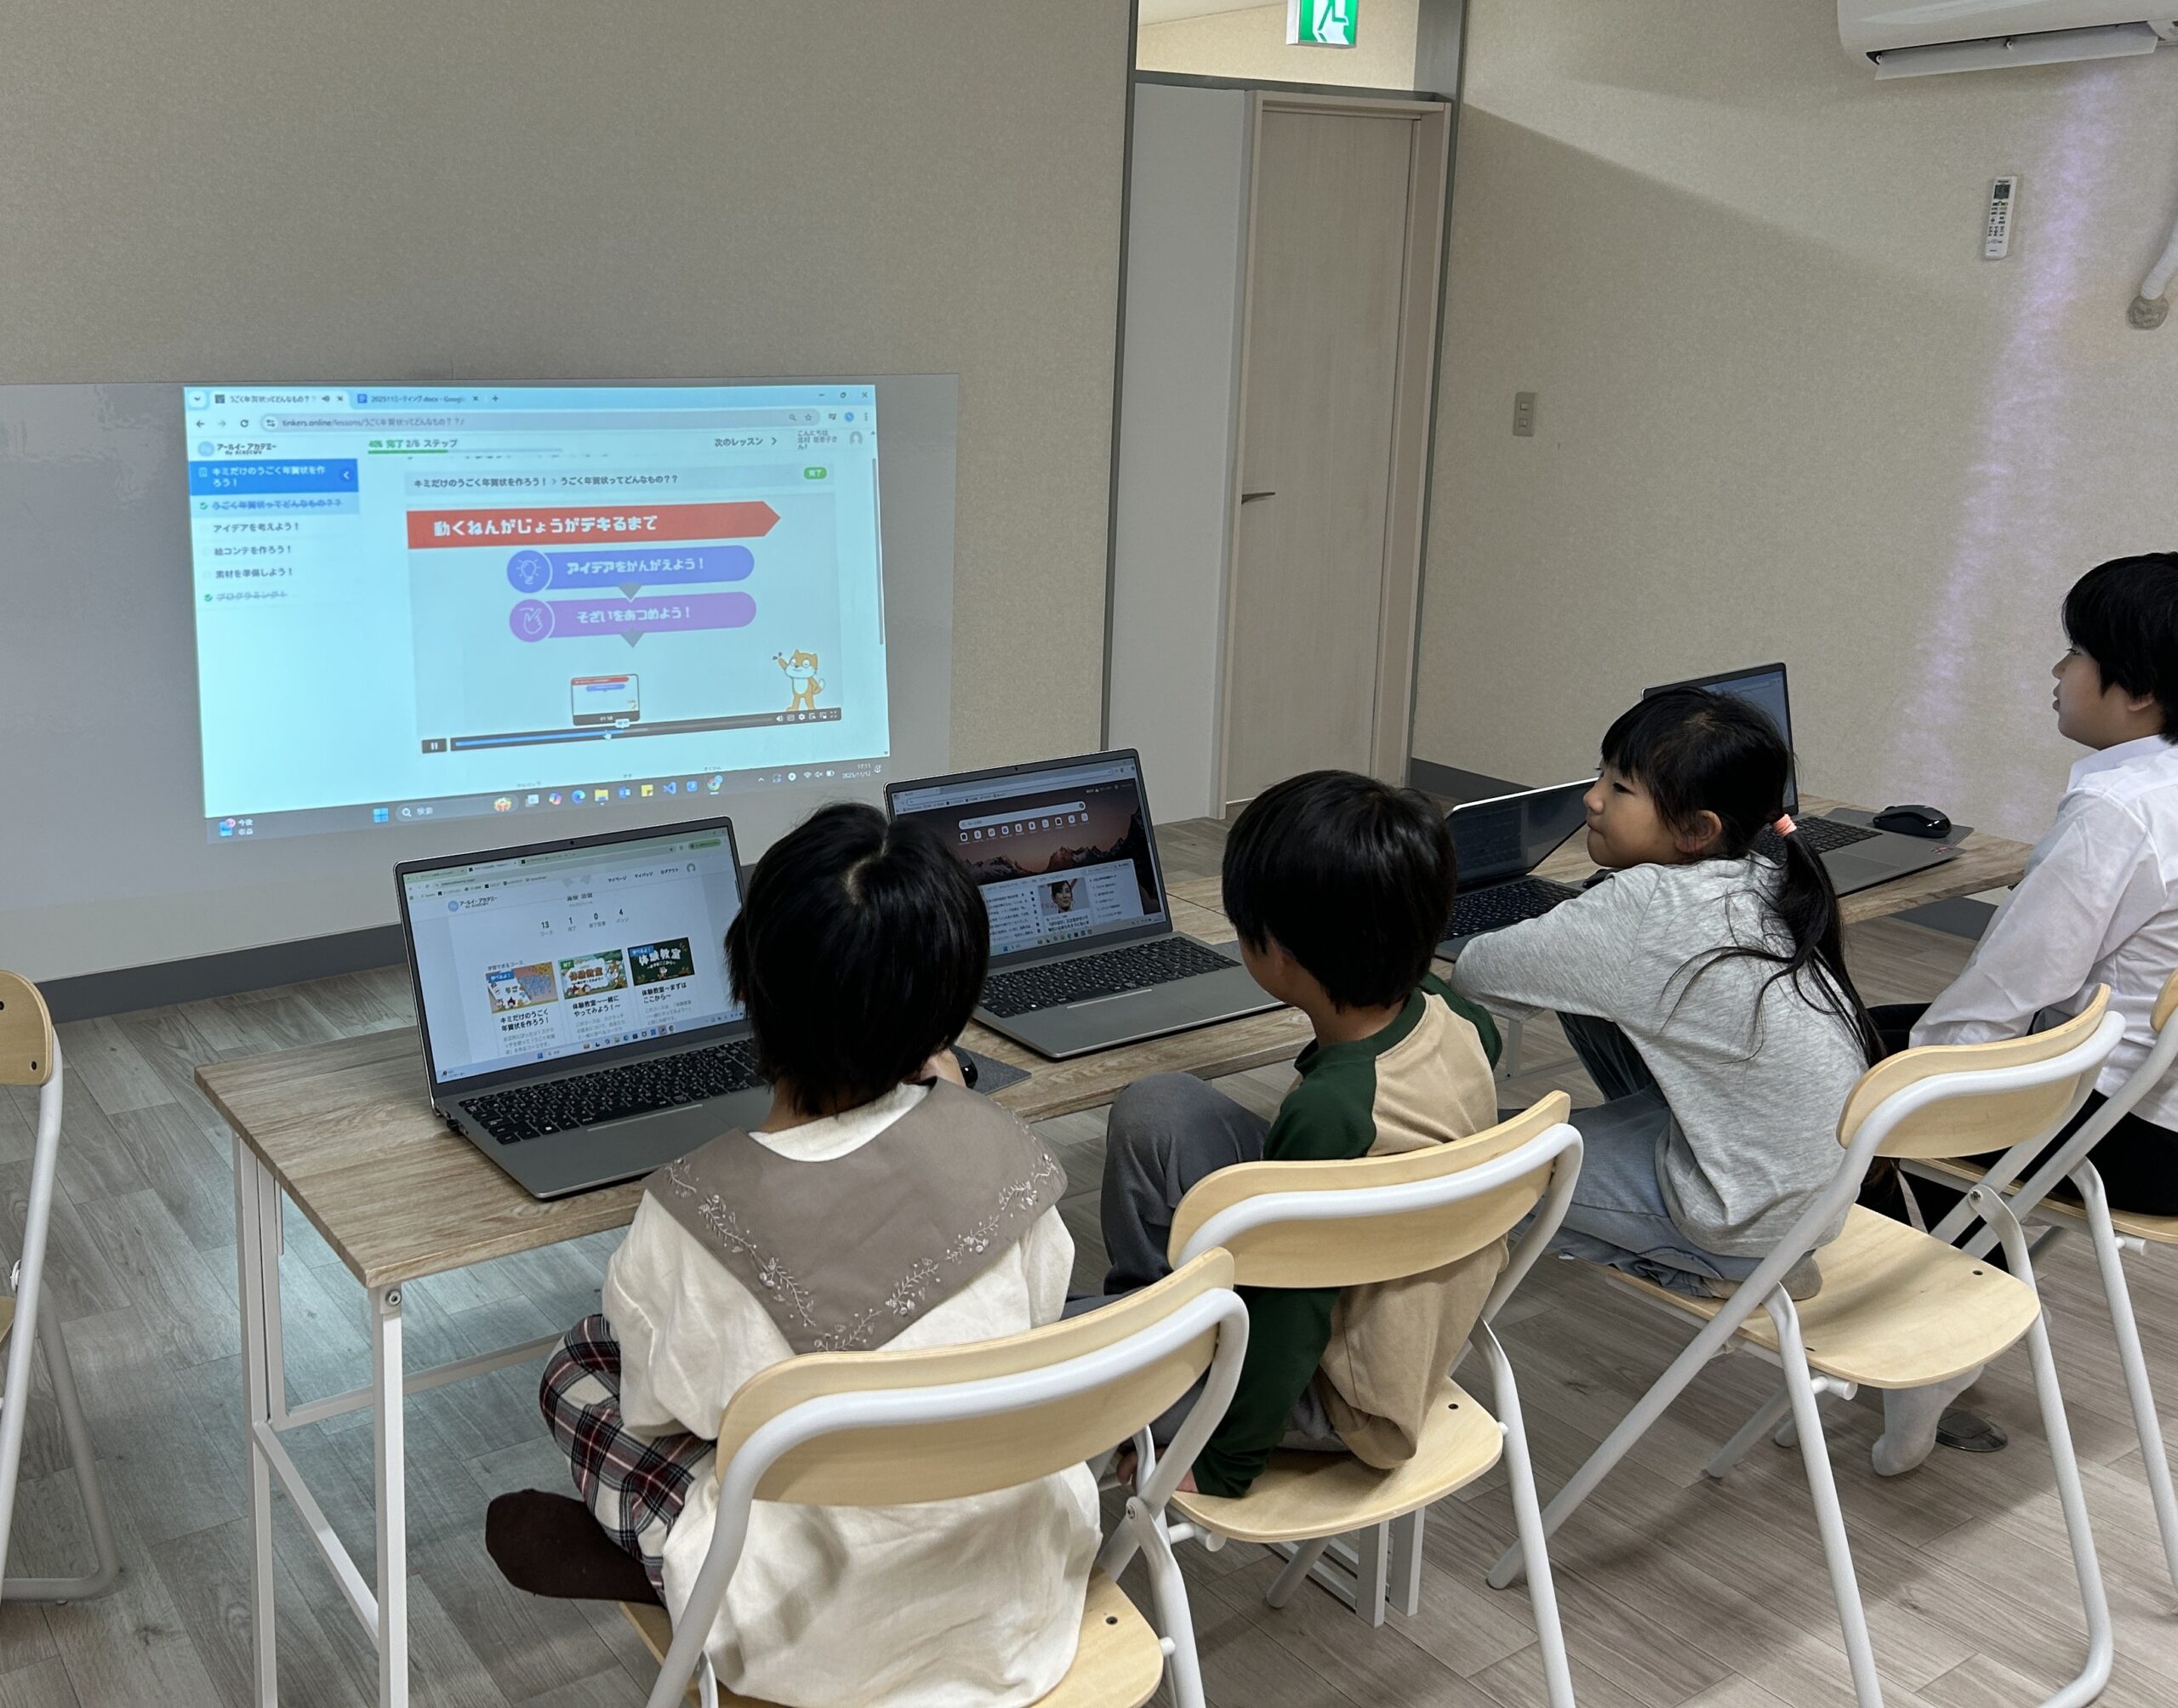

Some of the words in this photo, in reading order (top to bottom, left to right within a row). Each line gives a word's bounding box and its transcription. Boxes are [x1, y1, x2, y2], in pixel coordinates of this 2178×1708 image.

[248, 442, 277, 451] アカデミー
[385, 438, 404, 449] 完了
[424, 437, 459, 449] ステップ
[715, 436, 764, 447] 次のレッスン
[213, 465, 326, 476] キミだけのうごく年賀状を作
[414, 476, 546, 488] キミだけのうごく年賀状を作ろう！
[561, 475, 679, 486] うごく年賀状ってどんなもの？？
[214, 521, 299, 533] アイデアを考えよう！
[434, 515, 658, 538] 動くねんがじょうがデキるまで
[214, 545, 292, 556] 絵コンテを作ろう！
[567, 557, 704, 576] アイデアをかんがえよう！
[215, 568, 293, 579] 素材を準備しよう！
[577, 606, 691, 624] そざいをあつめよう！
[541, 920, 550, 930] 13
[593, 912, 599, 920] 0
[619, 908, 624, 916] 4
[500, 1008, 550, 1024] キミだけのうごく
[501, 1016, 550, 1032] 年賀状を作ろう！
